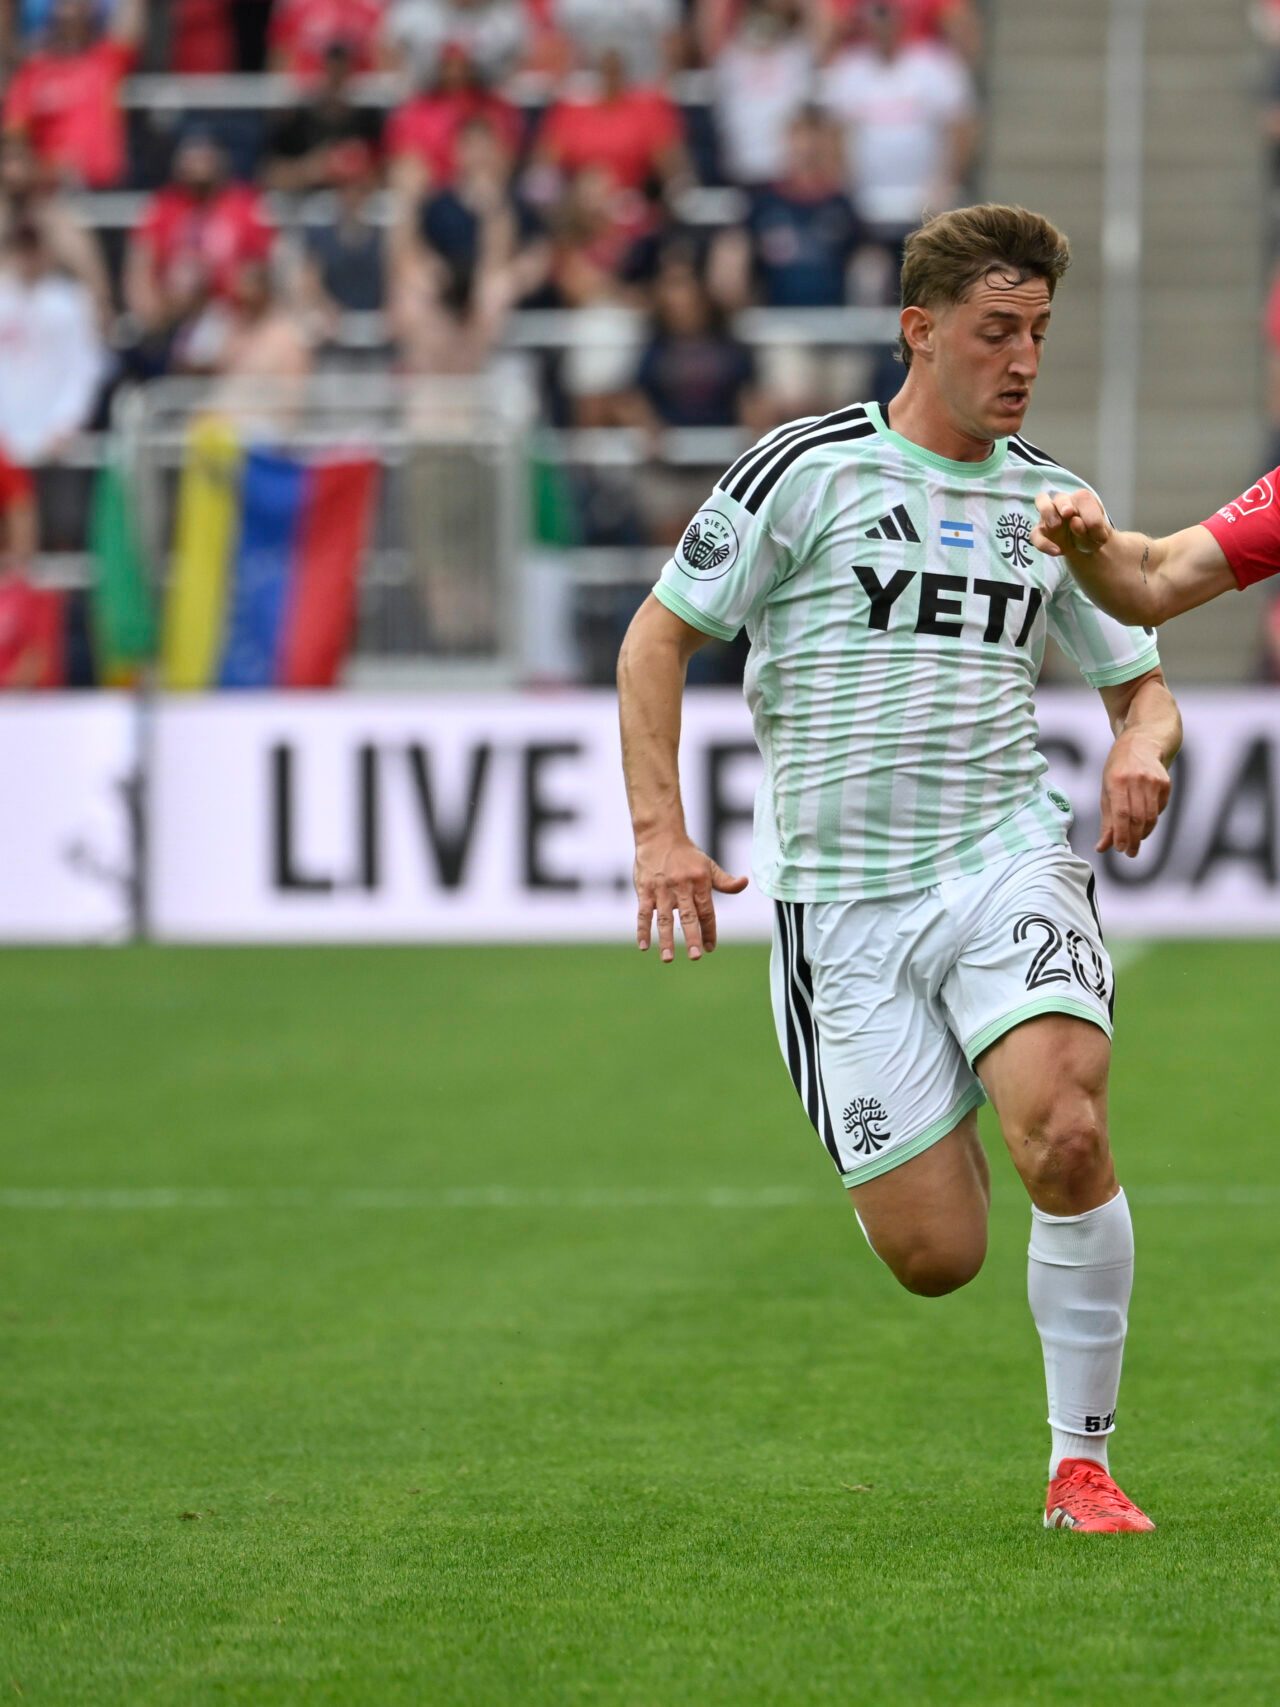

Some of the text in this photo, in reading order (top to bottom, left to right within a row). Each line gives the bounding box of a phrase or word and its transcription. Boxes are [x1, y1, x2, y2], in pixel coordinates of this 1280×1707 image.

[704, 518, 730, 540] SIETE
[851, 565, 1043, 647] YETI
[271, 739, 634, 894] LIVE.
[1012, 913, 1107, 1000] 20
